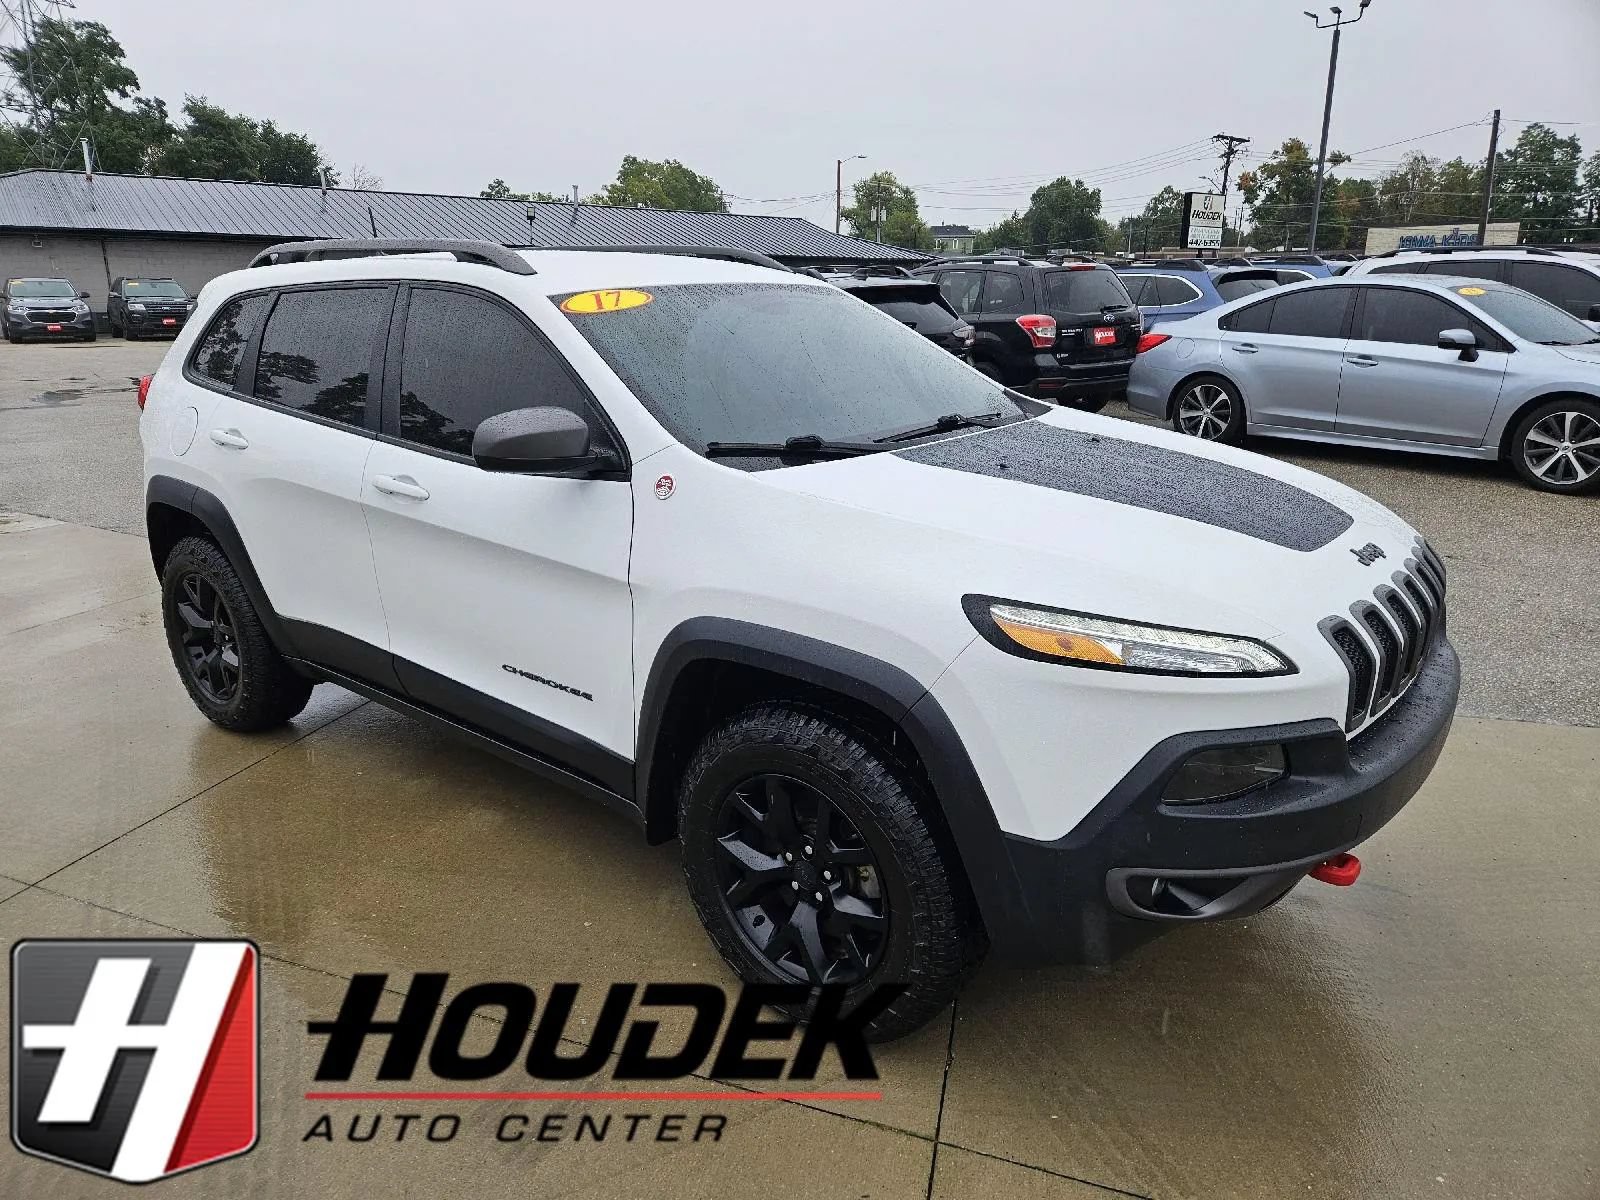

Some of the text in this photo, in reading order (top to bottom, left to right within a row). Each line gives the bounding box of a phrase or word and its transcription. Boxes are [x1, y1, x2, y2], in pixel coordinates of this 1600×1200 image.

[1191, 209, 1222, 220] HOUDEK
[1399, 234, 1436, 248] IOWA
[591, 291, 621, 310] 17
[502, 664, 593, 701] CHEROKEE
